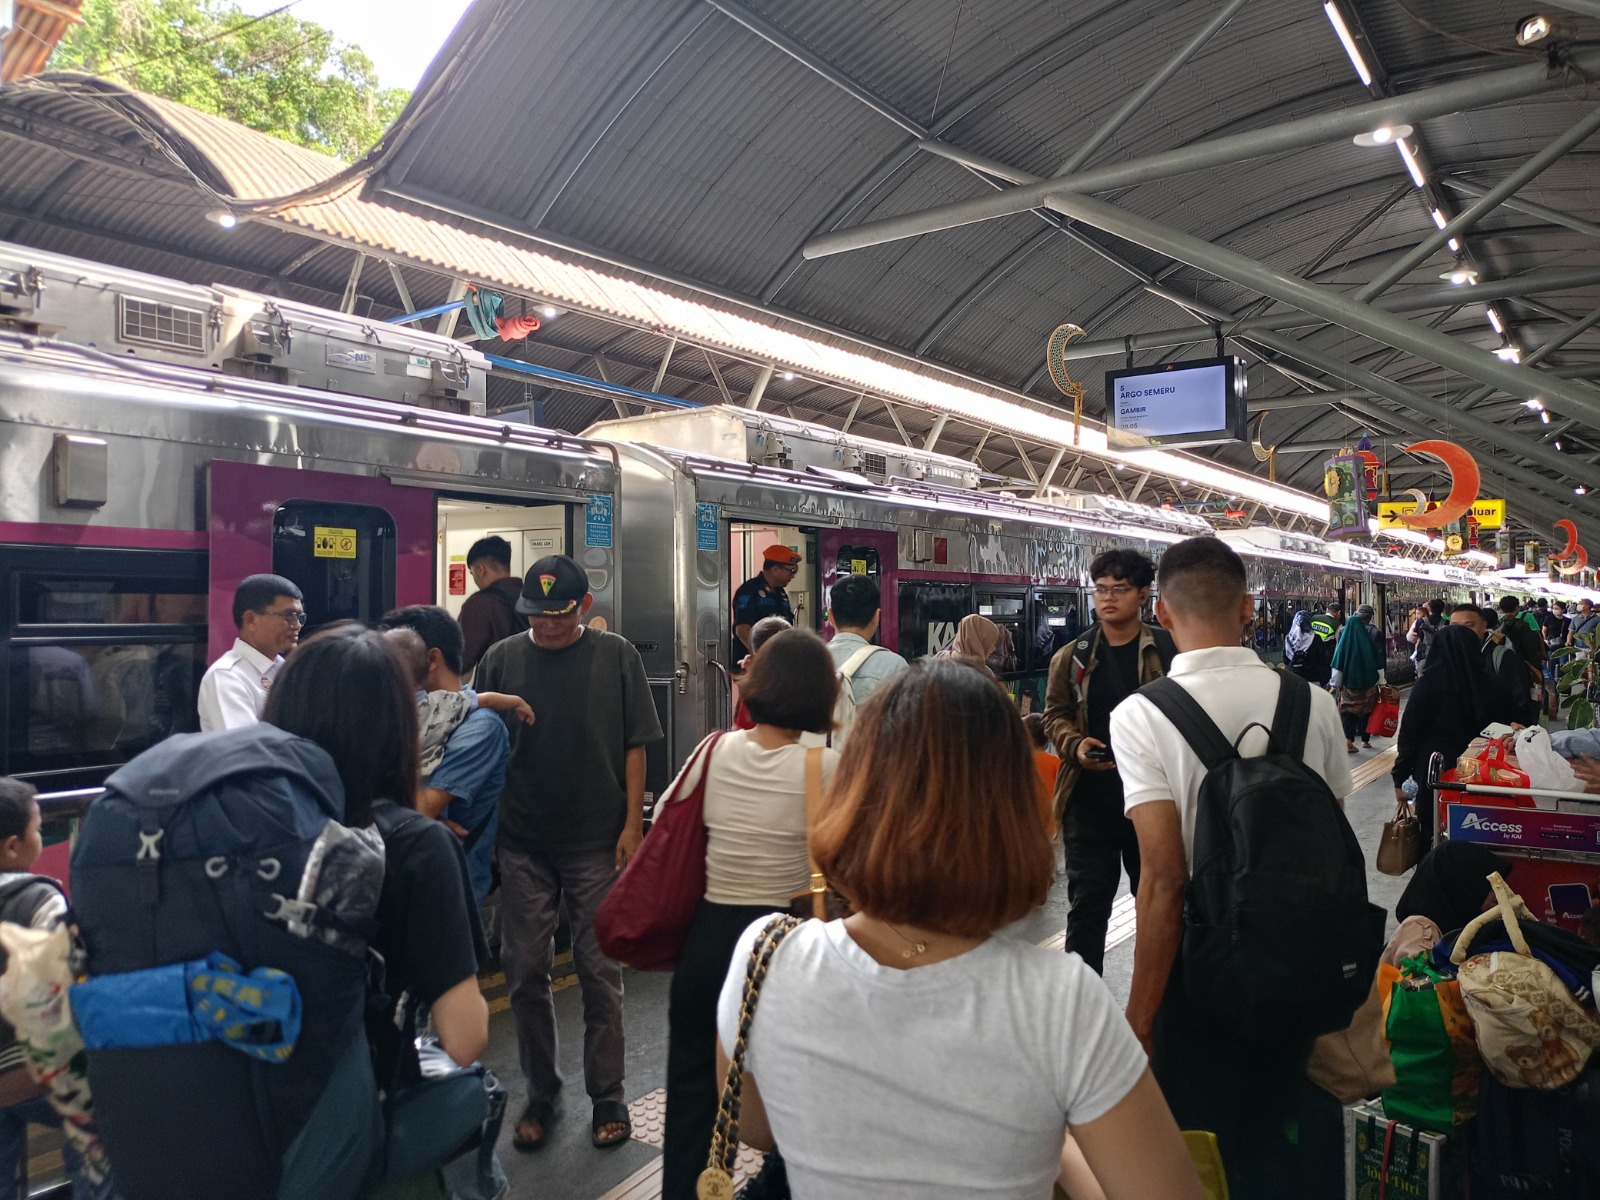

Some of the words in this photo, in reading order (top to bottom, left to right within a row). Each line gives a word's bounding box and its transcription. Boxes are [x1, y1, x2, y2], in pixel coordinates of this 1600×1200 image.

[1120, 391, 1142, 399] ARGO
[1144, 387, 1175, 396] SEMERU
[1474, 507, 1496, 516] luar
[1313, 624, 1329, 633] SATPAM
[927, 621, 961, 657] KA
[1460, 812, 1523, 833] Access
